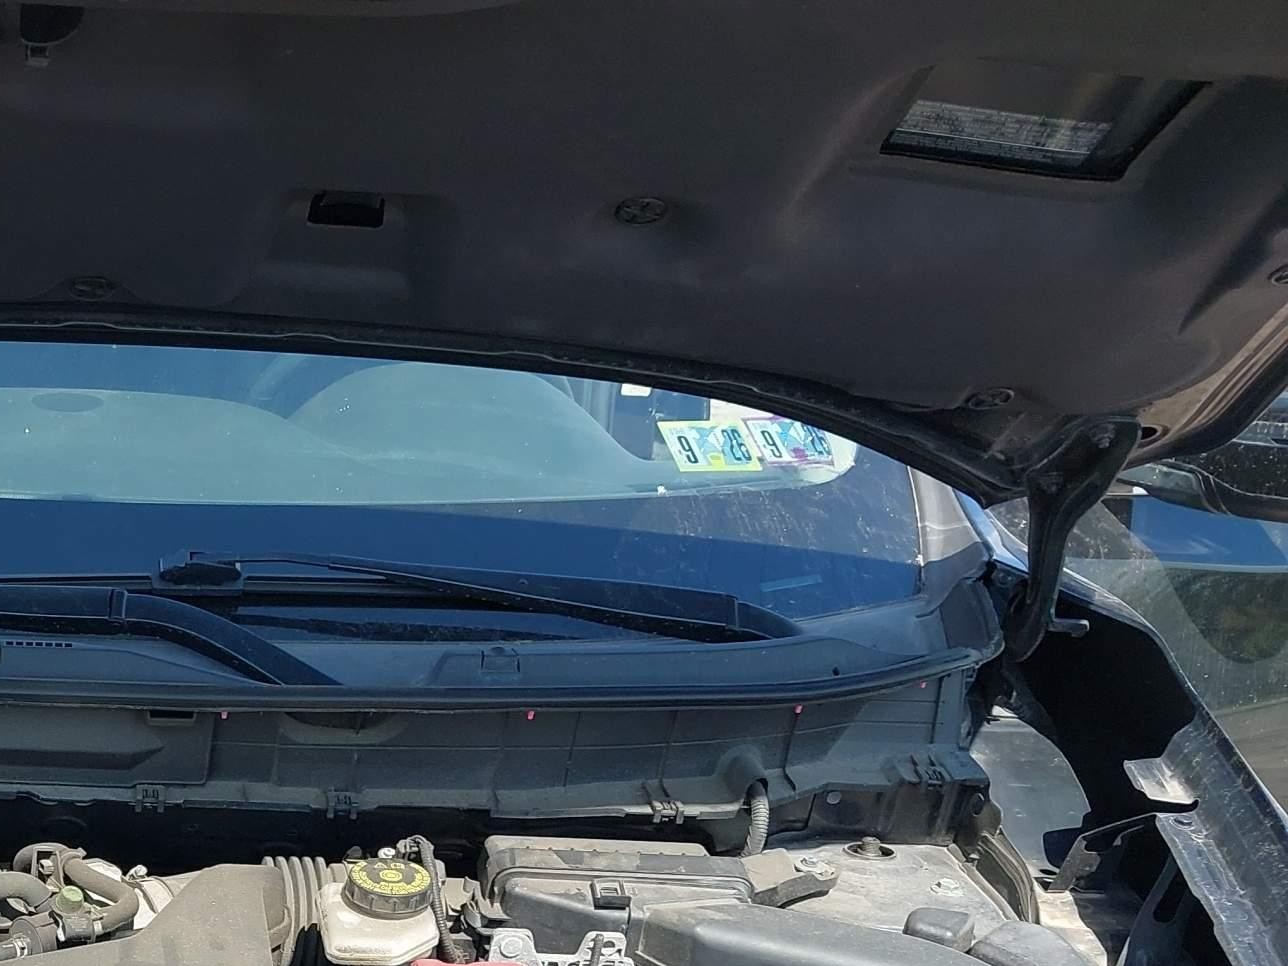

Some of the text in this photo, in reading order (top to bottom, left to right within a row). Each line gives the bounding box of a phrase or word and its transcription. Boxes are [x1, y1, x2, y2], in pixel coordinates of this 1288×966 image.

[677, 429, 752, 464] 9 26
[760, 430, 783, 458] 9
